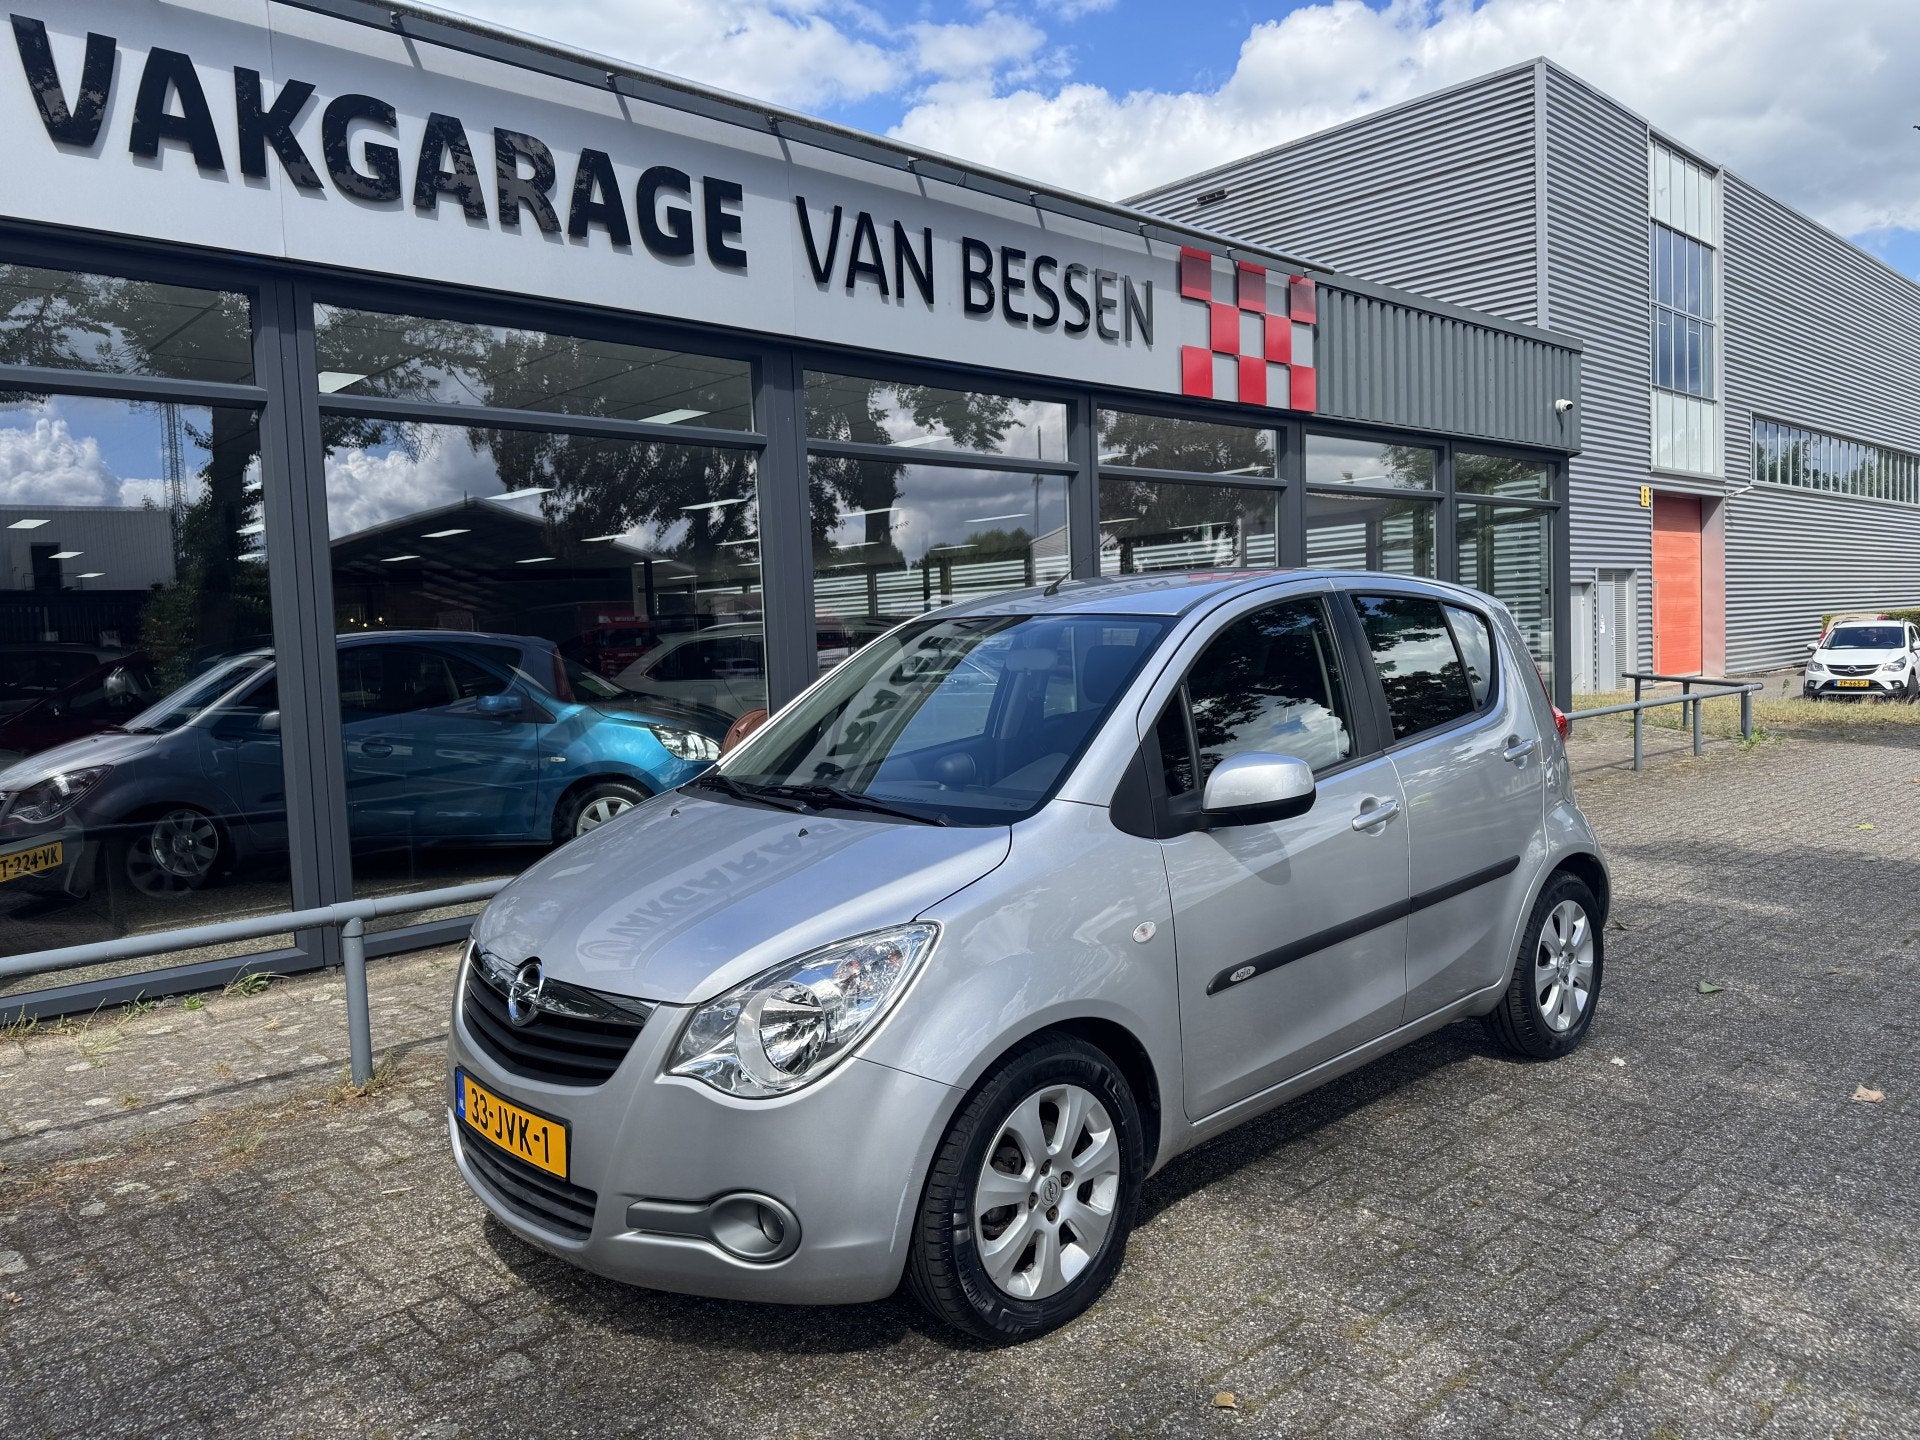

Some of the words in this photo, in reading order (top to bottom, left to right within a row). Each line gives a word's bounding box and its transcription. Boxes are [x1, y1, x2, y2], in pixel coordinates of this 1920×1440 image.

[10, 13, 748, 268] VAKGARAGE
[795, 195, 935, 305] VAN
[961, 236, 1154, 346] BESSEN
[471, 1087, 550, 1164] 33-JVK-1
